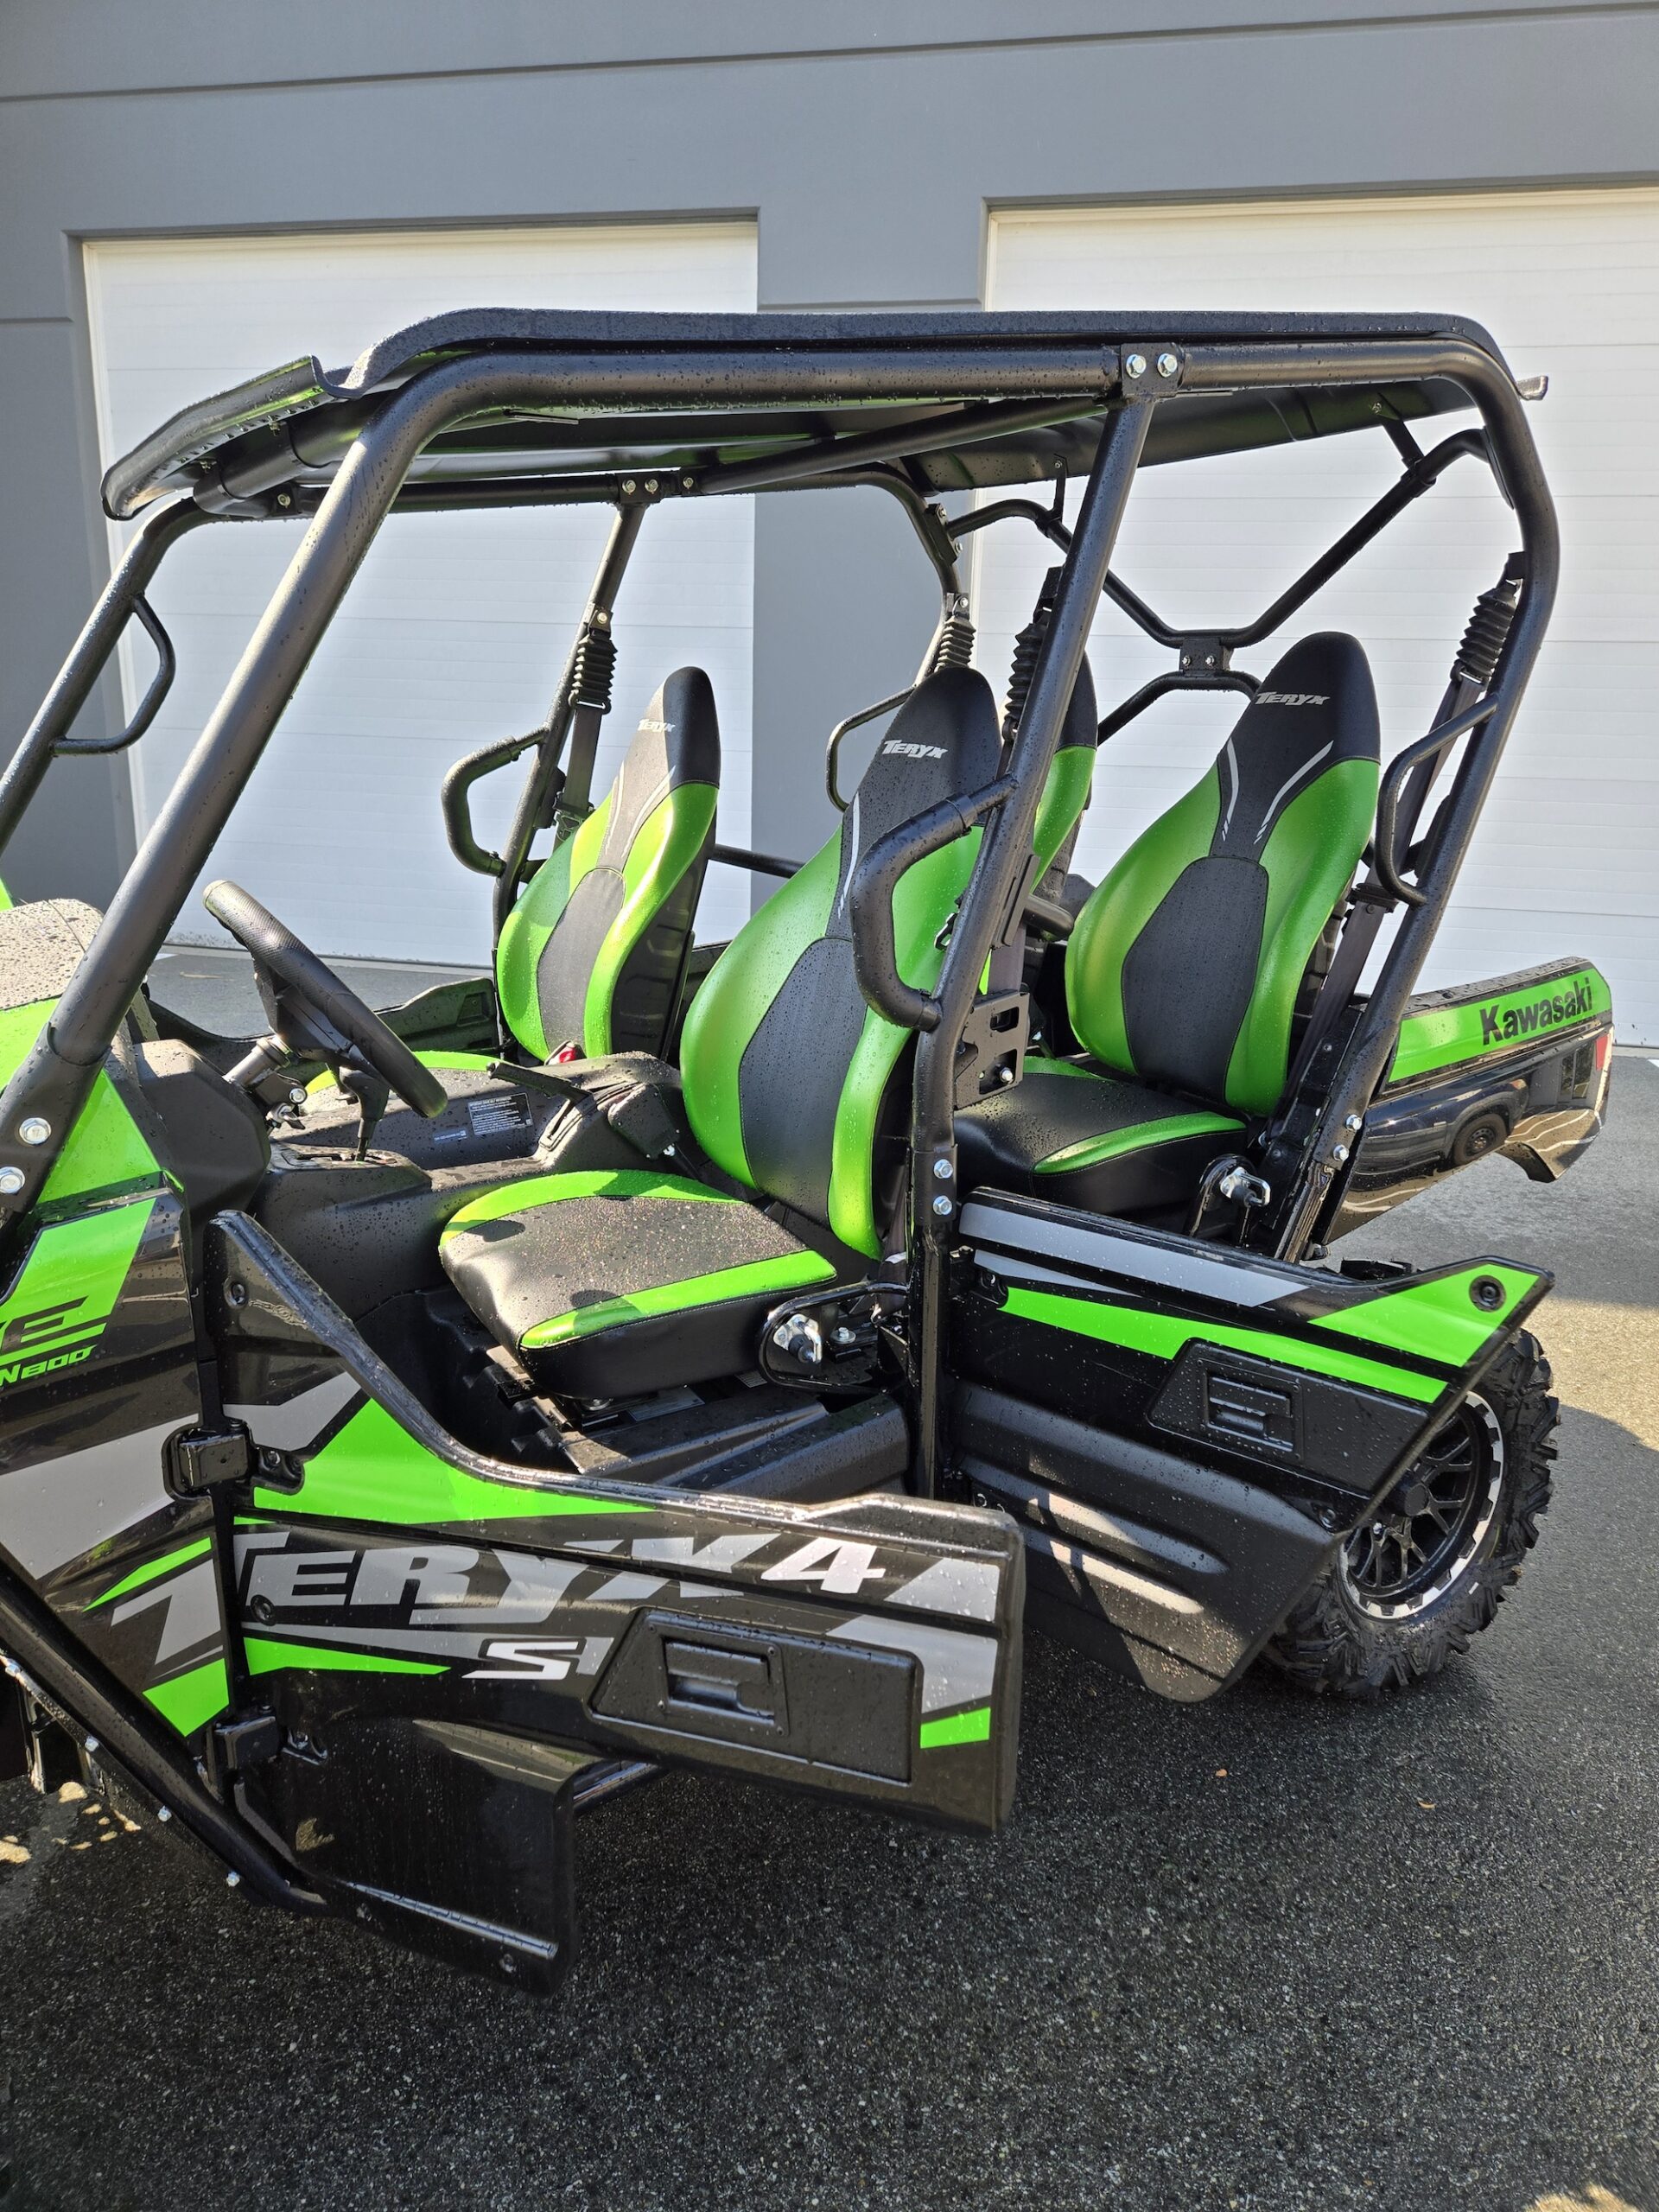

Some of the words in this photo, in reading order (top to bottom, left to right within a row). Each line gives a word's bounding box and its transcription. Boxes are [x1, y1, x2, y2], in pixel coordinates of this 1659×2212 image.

[1255, 691, 1331, 706] TERYX
[882, 739, 948, 759] TERYX
[1479, 977, 1592, 1046] Kawasaki
